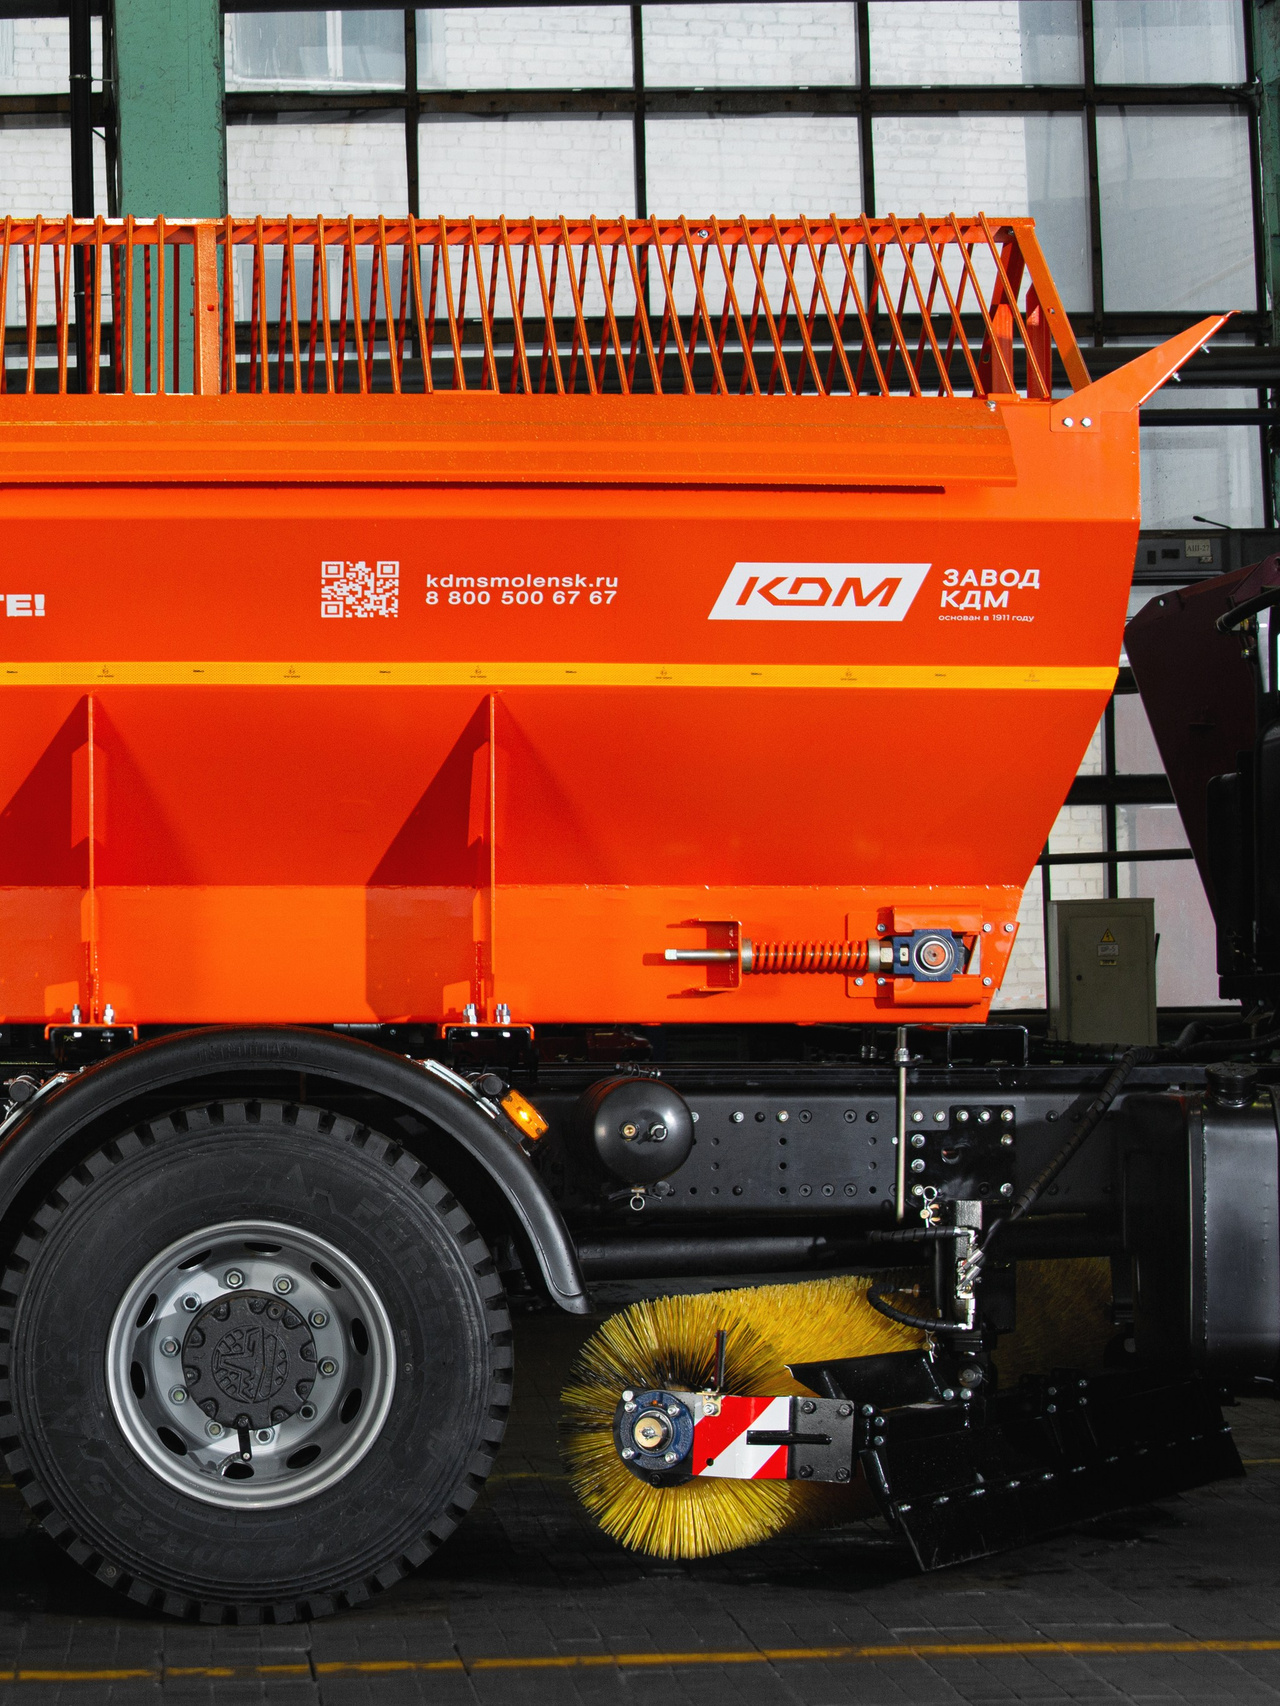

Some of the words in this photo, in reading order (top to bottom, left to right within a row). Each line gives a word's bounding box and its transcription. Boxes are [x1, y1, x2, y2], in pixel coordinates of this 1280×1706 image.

[426, 574, 619, 588] kdmsmolensk.ru
[941, 568, 1041, 589] ЗАВОД
[426, 591, 439, 605] 8
[448, 591, 491, 605] 800
[502, 591, 544, 605] 500
[553, 591, 581, 605] 67
[590, 591, 617, 605] 67
[736, 576, 903, 607] KDM
[940, 590, 1010, 611] КДМ
[938, 614, 981, 622] основан
[992, 613, 1010, 621] 1911
[1011, 615, 1035, 624] году
